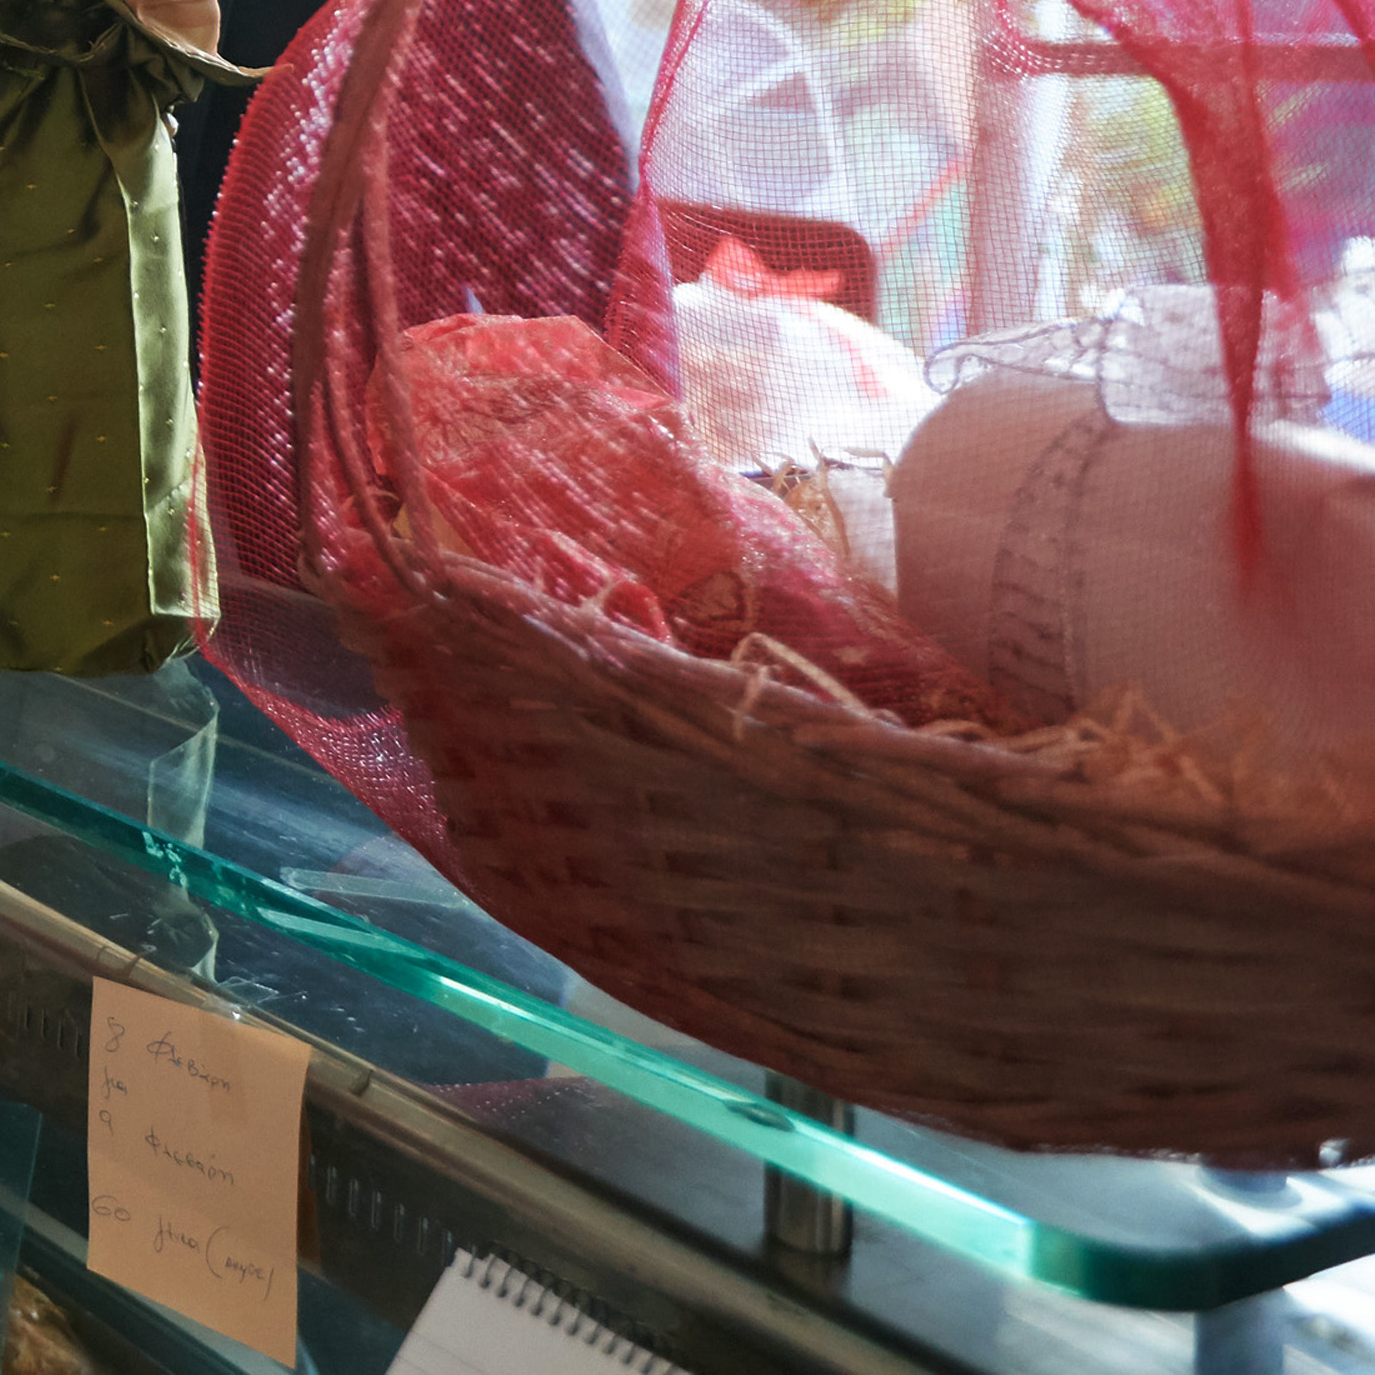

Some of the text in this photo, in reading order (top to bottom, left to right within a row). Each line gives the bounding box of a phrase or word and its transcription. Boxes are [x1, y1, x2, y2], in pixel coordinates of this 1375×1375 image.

[105, 1016, 126, 1053] 8
[99, 1109, 115, 1137] 9
[91, 1194, 131, 1222] 60
